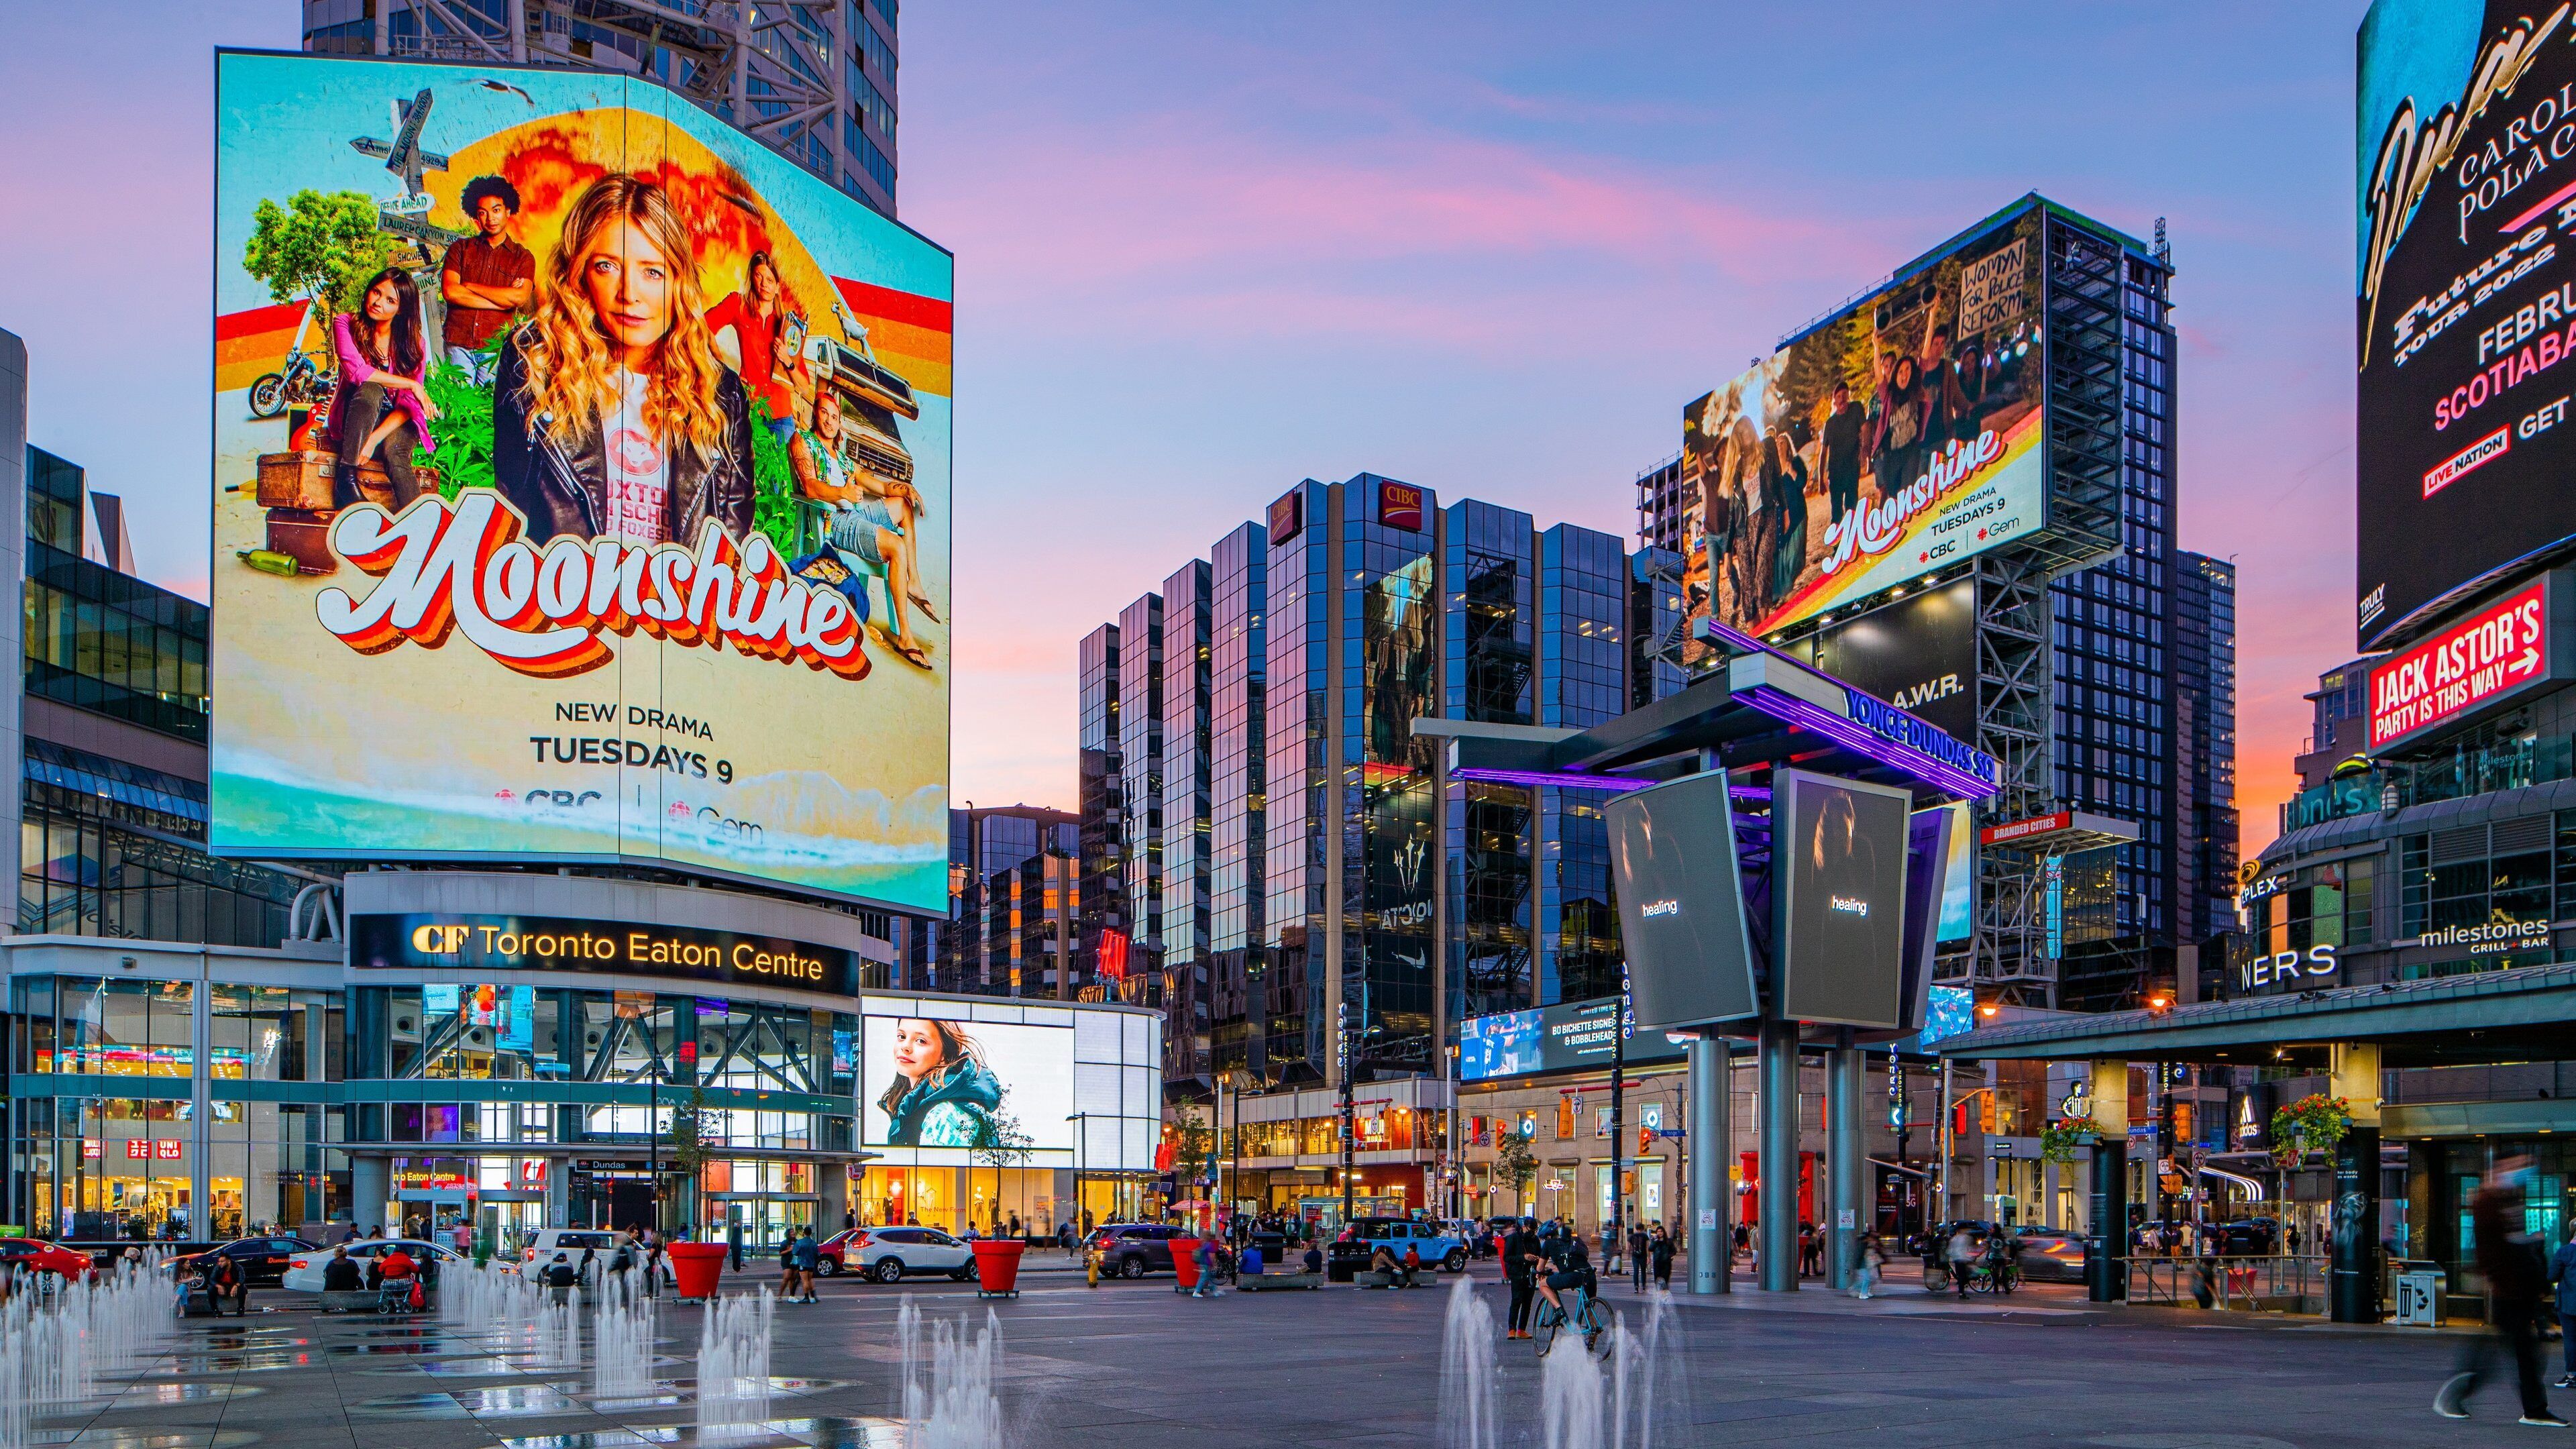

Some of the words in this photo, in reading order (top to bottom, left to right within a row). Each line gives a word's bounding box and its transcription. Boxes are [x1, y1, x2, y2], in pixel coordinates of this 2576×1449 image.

[393, 153, 404, 168] THE
[400, 126, 417, 153] MOON
[380, 201, 399, 212] OFFICE
[401, 197, 427, 210] AHEAD
[383, 217, 414, 233] LAUREL
[415, 226, 445, 240] CANYON
[1965, 242, 2024, 290] WOMYN
[1962, 286, 1982, 315] FOR
[1988, 270, 2023, 300] POLICE
[2394, 226, 2547, 348] Future
[2394, 300, 2469, 367] TOUR
[2474, 244, 2555, 307] 2022
[1960, 289, 2022, 338] REFORM
[2518, 396, 2569, 440] GET
[2428, 465, 2453, 490] LIVE
[2455, 435, 2503, 472] NATION
[1271, 496, 1292, 521] CIBC
[1386, 486, 1419, 507] CIBC
[1822, 430, 2006, 575] Moonshine
[1939, 500, 1960, 517] NEW
[1963, 486, 1997, 507] DRAMA
[1931, 502, 1994, 537] TUESDAYS
[1998, 497, 2005, 511] 9
[1929, 539, 1956, 560] CBC
[1989, 517, 2019, 537] Gem
[317, 492, 865, 674] Moonshine
[2360, 583, 2385, 617] TRULY
[2375, 653, 2429, 716] JACK
[2435, 598, 2540, 688] ASTOR'S
[1893, 674, 1964, 710] A.W.R.
[2375, 702, 2417, 742] PARTY
[2420, 695, 2433, 722] IS
[2436, 678, 2469, 714] THIS
[2471, 660, 2506, 698] WAY
[555, 702, 617, 722] NEW
[629, 706, 714, 741] DRAMA
[1847, 690, 1973, 771] YONGE-DUNDAS
[1974, 751, 1996, 783] SQ
[530, 736, 708, 780] TUESDAYS
[716, 759, 733, 786] 9
[697, 806, 763, 845] Gem
[1994, 823, 2029, 840] BRANDED
[2030, 817, 2055, 832] CITIES
[1642, 900, 1678, 918] healing
[1831, 895, 1868, 916] healing
[2421, 918, 2548, 947] milestones
[2470, 942, 2508, 954] GRILL
[2522, 937, 2549, 949] BAR
[412, 926, 472, 953] CF
[478, 926, 616, 960] Toronto
[629, 933, 720, 968] Eaton
[733, 943, 822, 981] Centre
[1552, 1026, 1561, 1036] BO
[1562, 1021, 1592, 1034] BICHETTE
[160, 1141, 178, 1150] UNI
[1364, 1119, 1385, 1135] MJI
[160, 1149, 179, 1158] QLO
[593, 1161, 626, 1169] Dundas
[407, 1172, 429, 1181] Eaton
[1906, 1198, 1916, 1208] 5G
